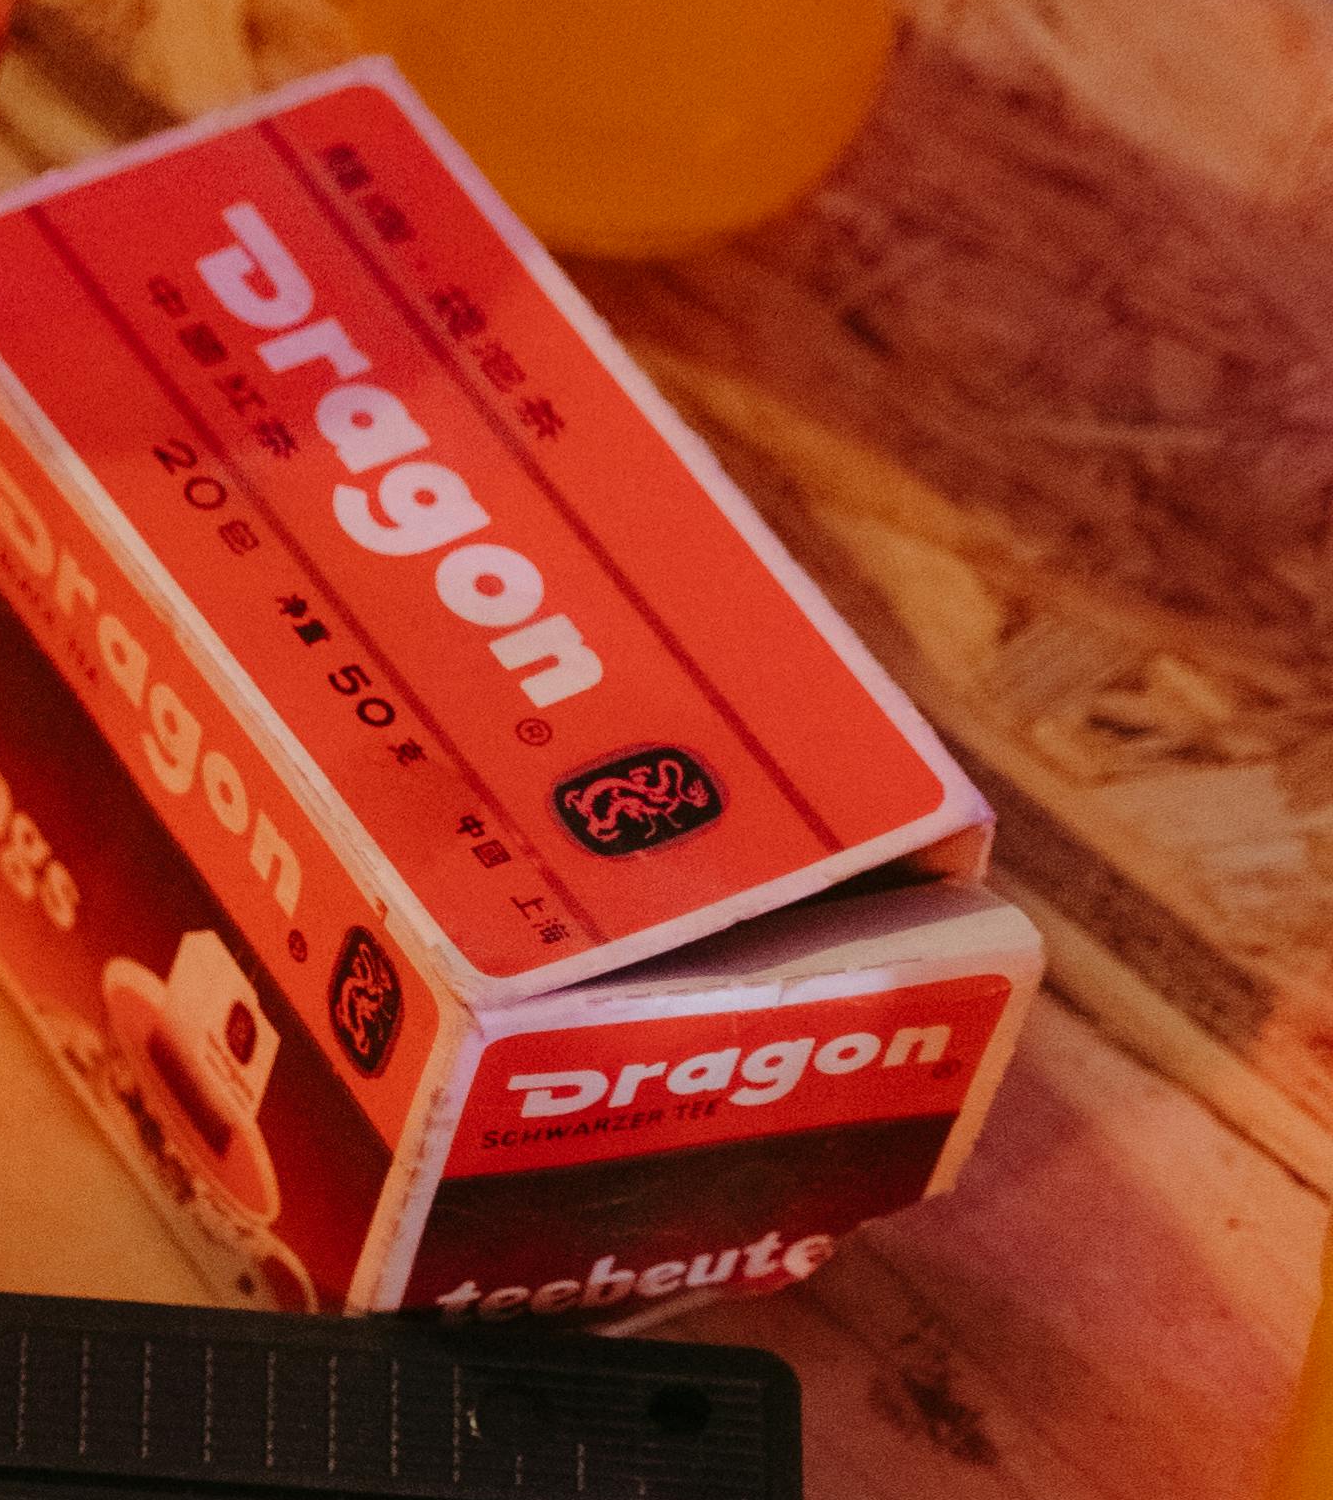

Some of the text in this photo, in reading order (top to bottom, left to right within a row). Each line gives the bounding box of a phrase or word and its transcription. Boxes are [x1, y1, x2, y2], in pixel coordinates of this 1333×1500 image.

[192, 200, 605, 711] Dragon
[507, 884, 573, 950] 上海
[505, 1024, 953, 1119] Dragon
[480, 1095, 724, 1150] SCHWARZER TEE
